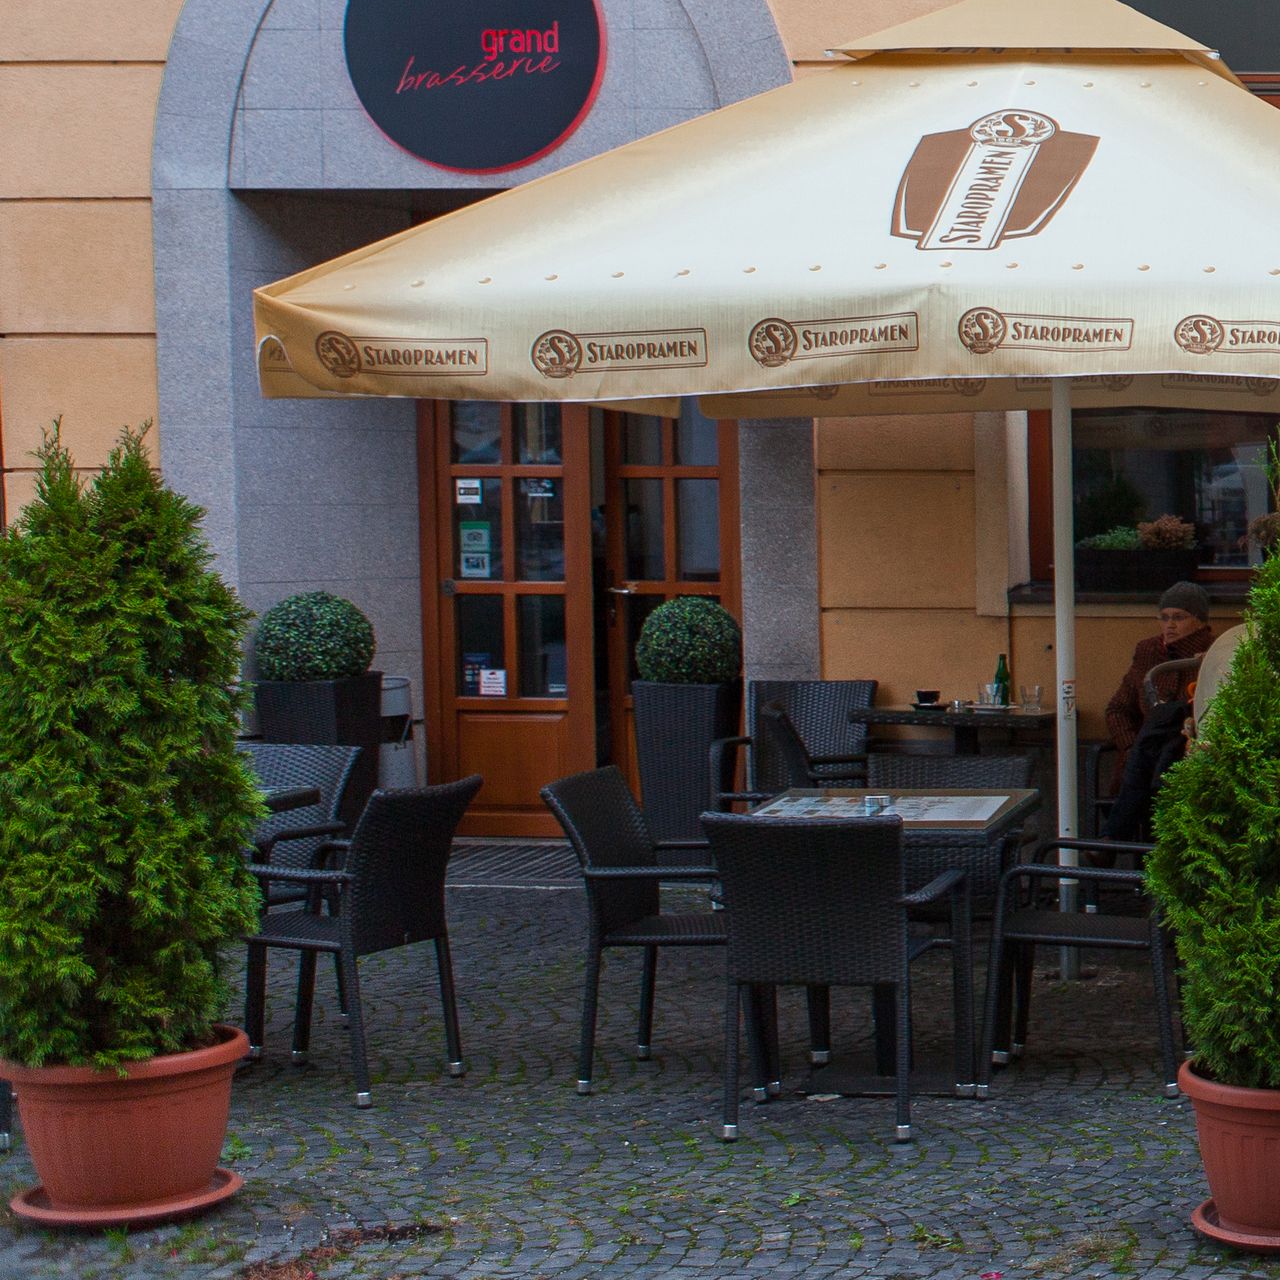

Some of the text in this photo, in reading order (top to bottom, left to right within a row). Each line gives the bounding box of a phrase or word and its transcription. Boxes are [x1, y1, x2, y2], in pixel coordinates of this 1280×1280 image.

[480, 20, 559, 62] grand
[395, 55, 562, 94] brasserie
[939, 149, 1018, 244] STAROPRAMEN
[801, 322, 909, 351] STAROPRAMEN
[1011, 322, 1124, 343] STAROPRAMEN
[363, 345, 478, 366] STAROPRAMEN
[587, 339, 698, 363] STAROPRAMEN
